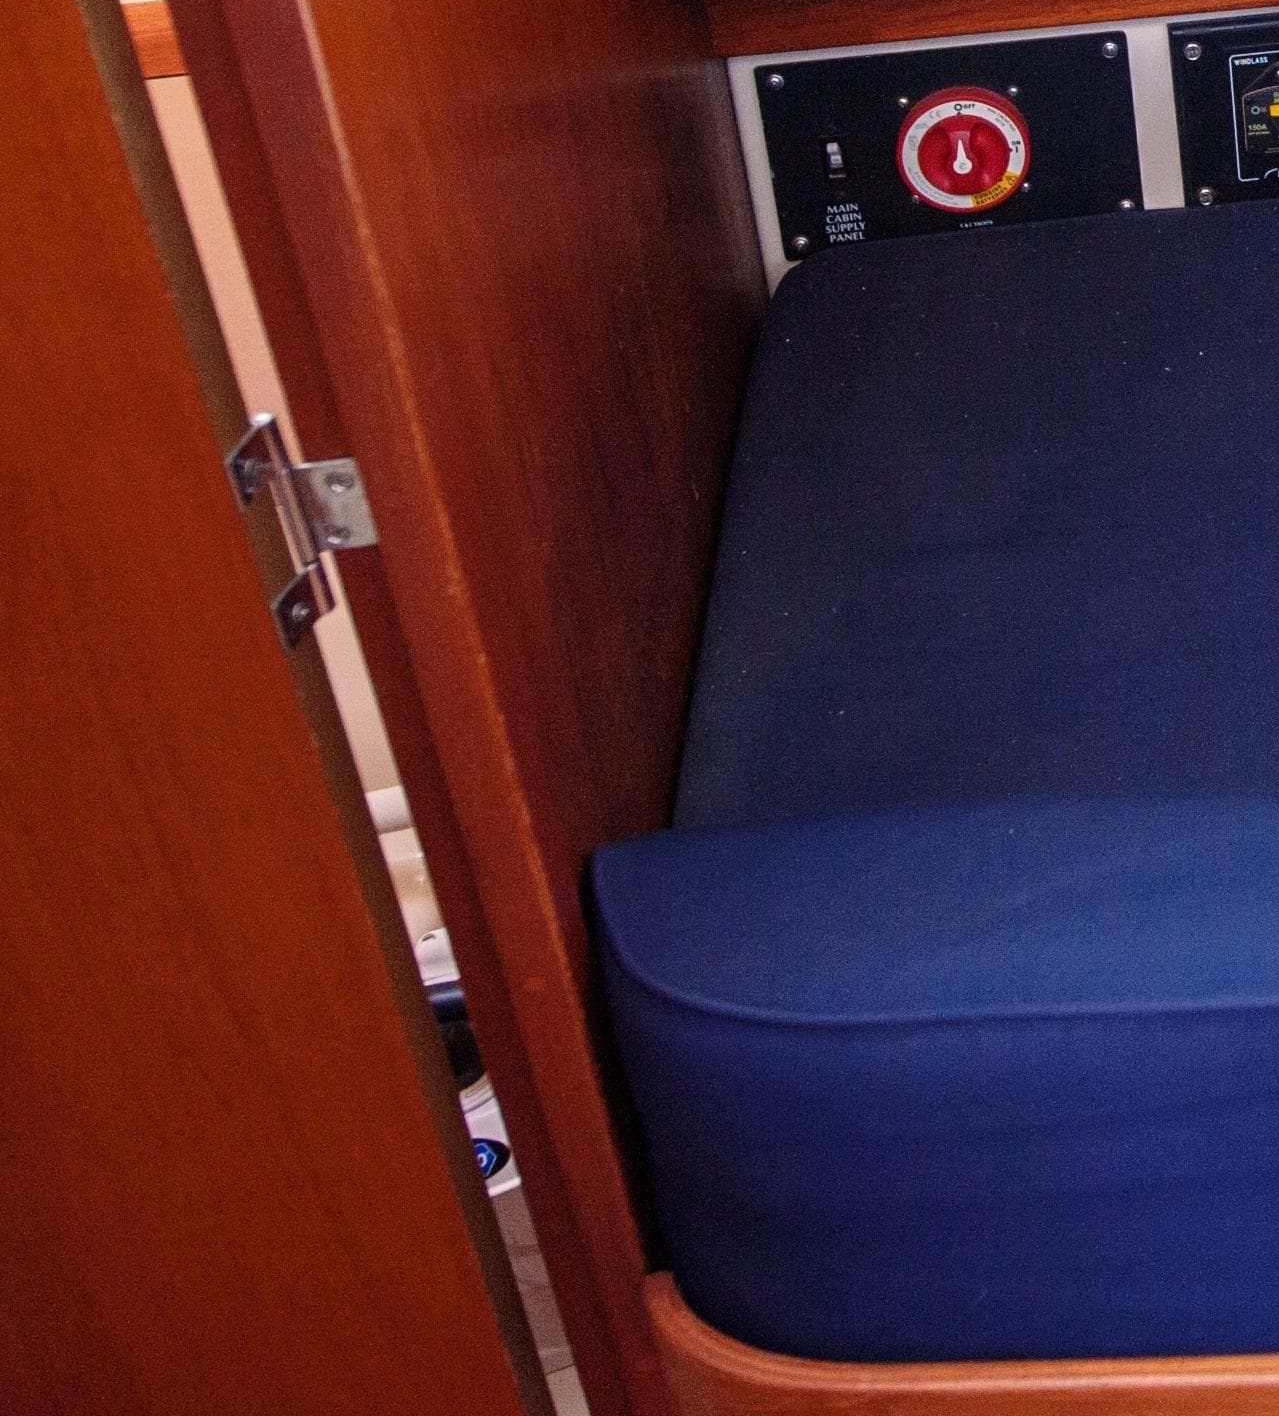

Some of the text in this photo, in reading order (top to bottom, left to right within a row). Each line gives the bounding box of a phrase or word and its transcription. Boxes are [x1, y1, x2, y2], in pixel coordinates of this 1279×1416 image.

[1234, 56, 1268, 66] WINDLASS
[827, 203, 859, 214] MAIN
[826, 213, 862, 224] CABIN
[825, 221, 866, 234] SUPPLY
[830, 232, 865, 243] PANEL
